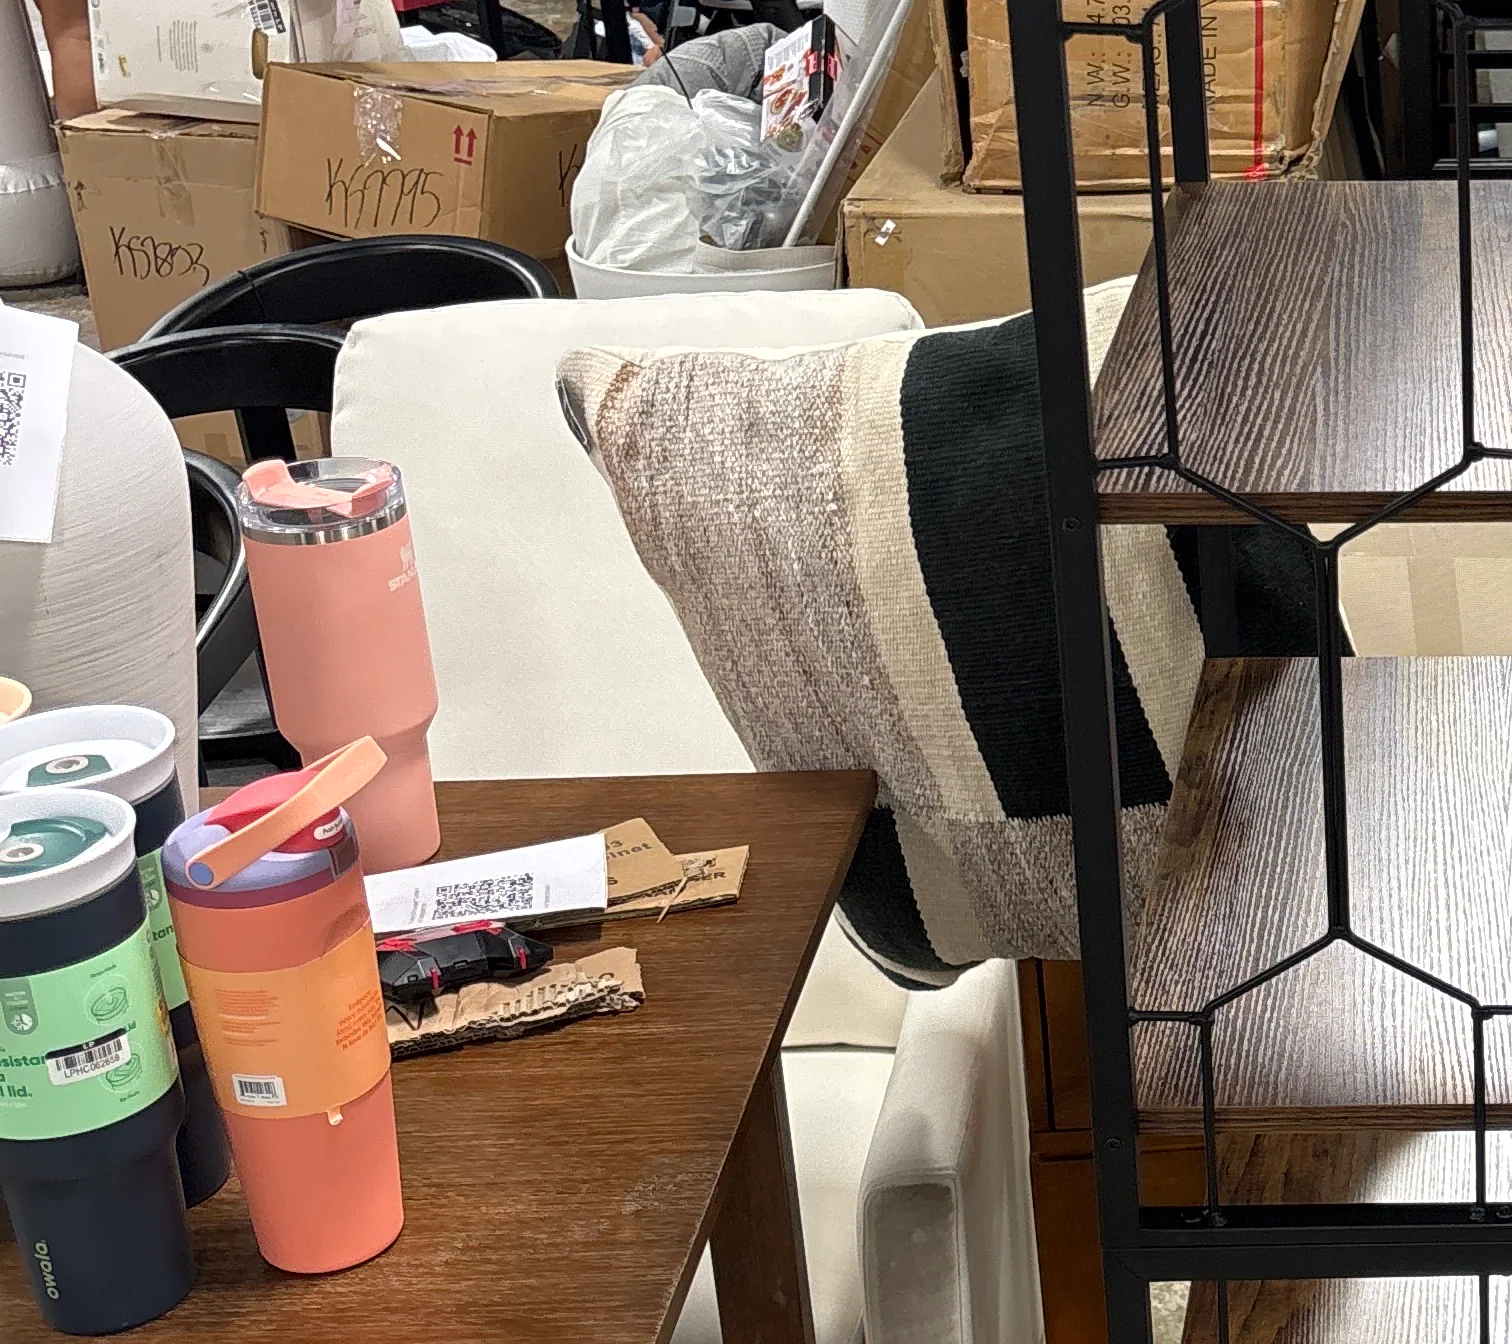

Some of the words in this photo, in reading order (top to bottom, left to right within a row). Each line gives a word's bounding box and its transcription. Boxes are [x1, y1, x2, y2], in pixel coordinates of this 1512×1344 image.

[1200, 16, 1218, 39] IN
[83, 1040, 96, 1050] LP
[34, 1242, 60, 1300] owala
